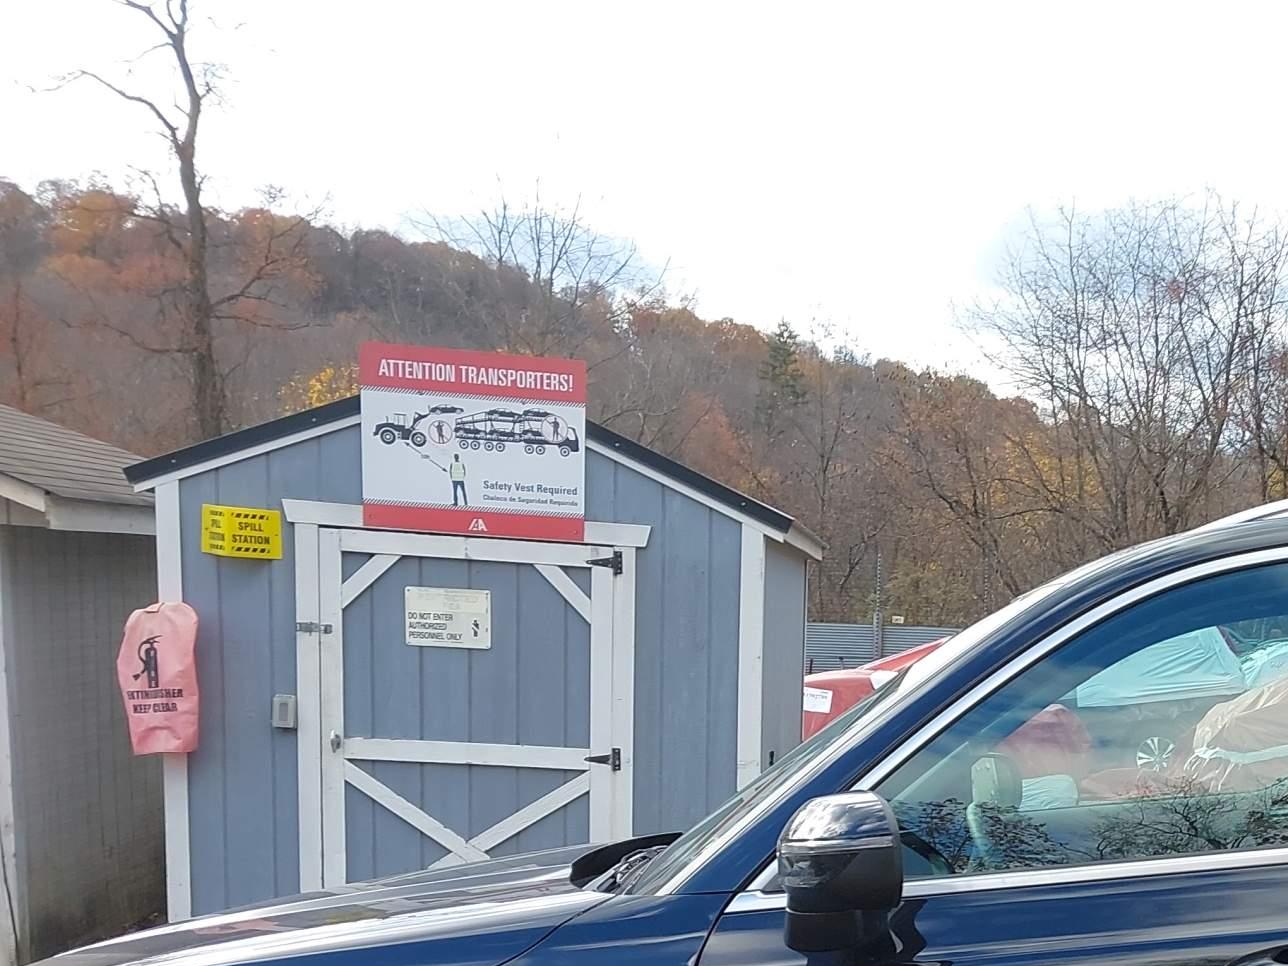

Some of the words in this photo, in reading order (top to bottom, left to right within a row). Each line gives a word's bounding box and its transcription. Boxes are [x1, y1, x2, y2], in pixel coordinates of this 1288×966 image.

[378, 358, 456, 383] ATTENTION
[459, 365, 574, 392] TRANSPORTERS!
[483, 480, 512, 493] Safety
[514, 482, 534, 492] Vest
[537, 484, 578, 496] Required
[238, 521, 264, 532] SPILL
[232, 534, 270, 545] STATION
[408, 612, 417, 620] DO
[419, 612, 432, 620] NOT
[433, 613, 453, 621] ENTER
[446, 632, 463, 641] ONLY
